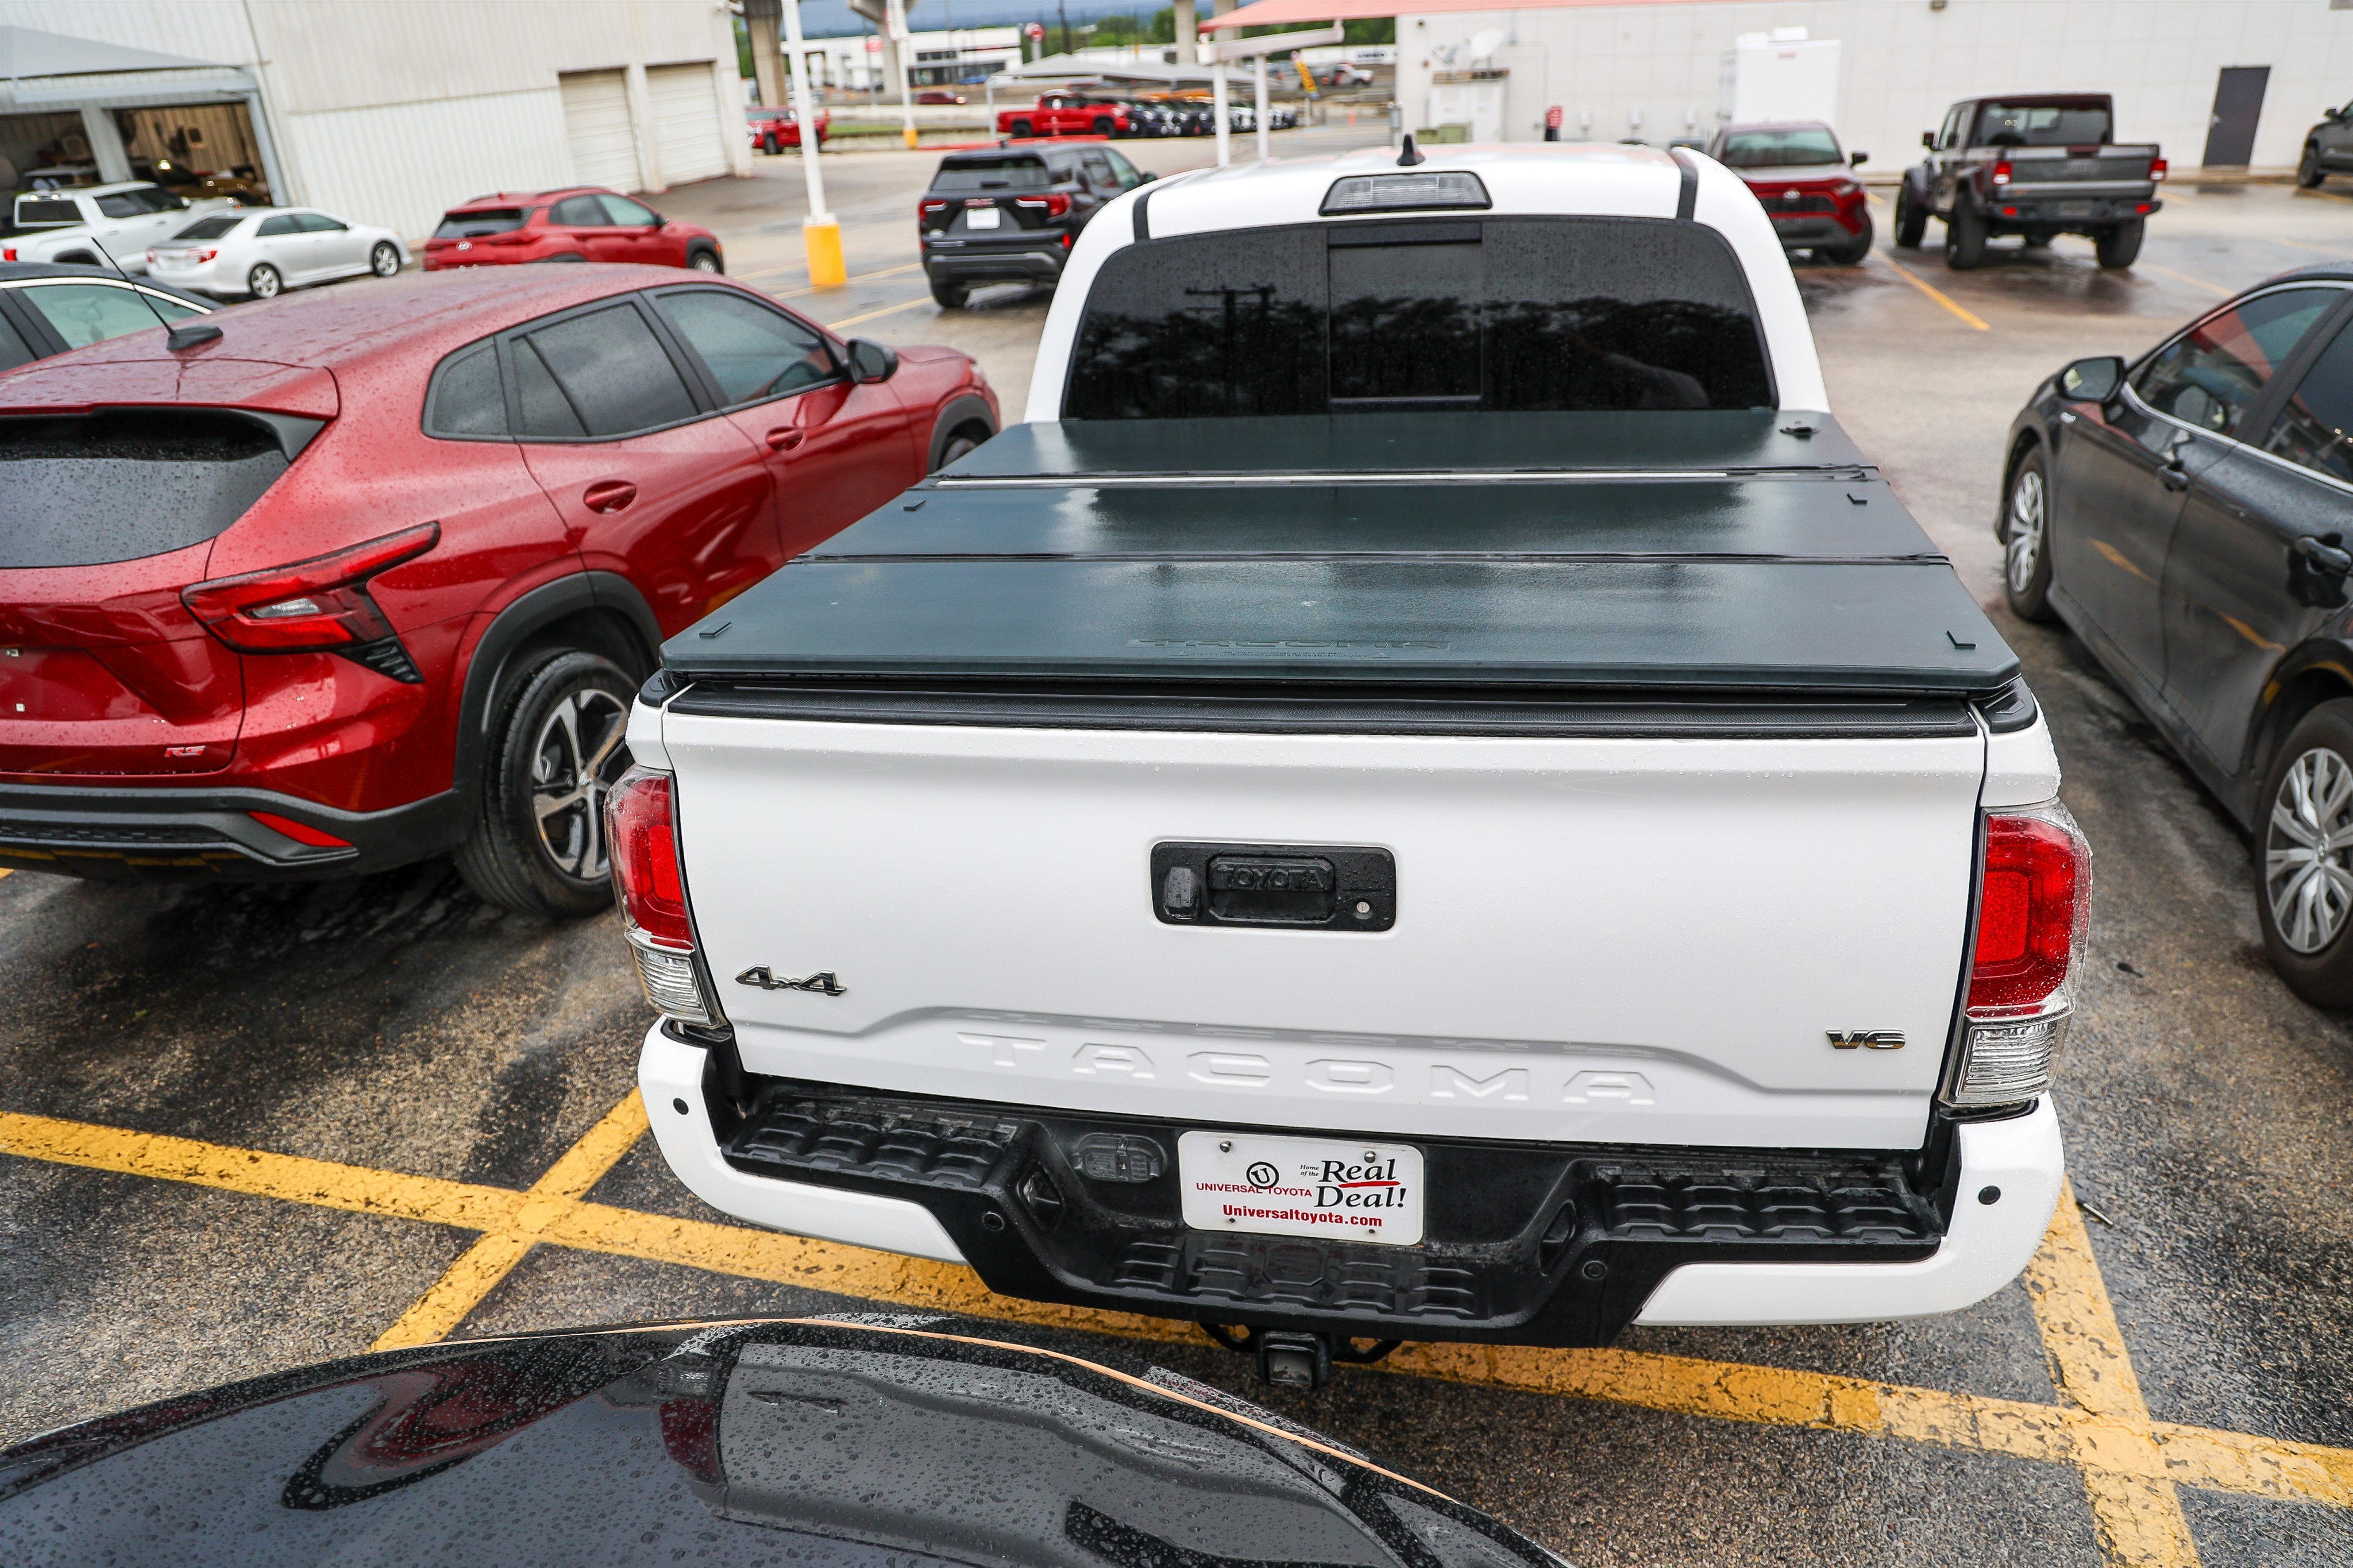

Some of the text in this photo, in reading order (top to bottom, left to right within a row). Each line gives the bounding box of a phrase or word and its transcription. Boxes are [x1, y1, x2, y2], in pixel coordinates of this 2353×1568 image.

[164, 746, 206, 757] RS
[1217, 868, 1325, 890] TOYOTA
[1826, 1030, 1905, 1049] V6
[957, 1032, 1655, 1105] TACOMA
[1318, 1159, 1396, 1183] Real
[1196, 1182, 1313, 1198] UNIVERSAL TOYOTA
[1314, 1185, 1407, 1208] Deal!
[1223, 1204, 1382, 1227] Universaltoyota.com
